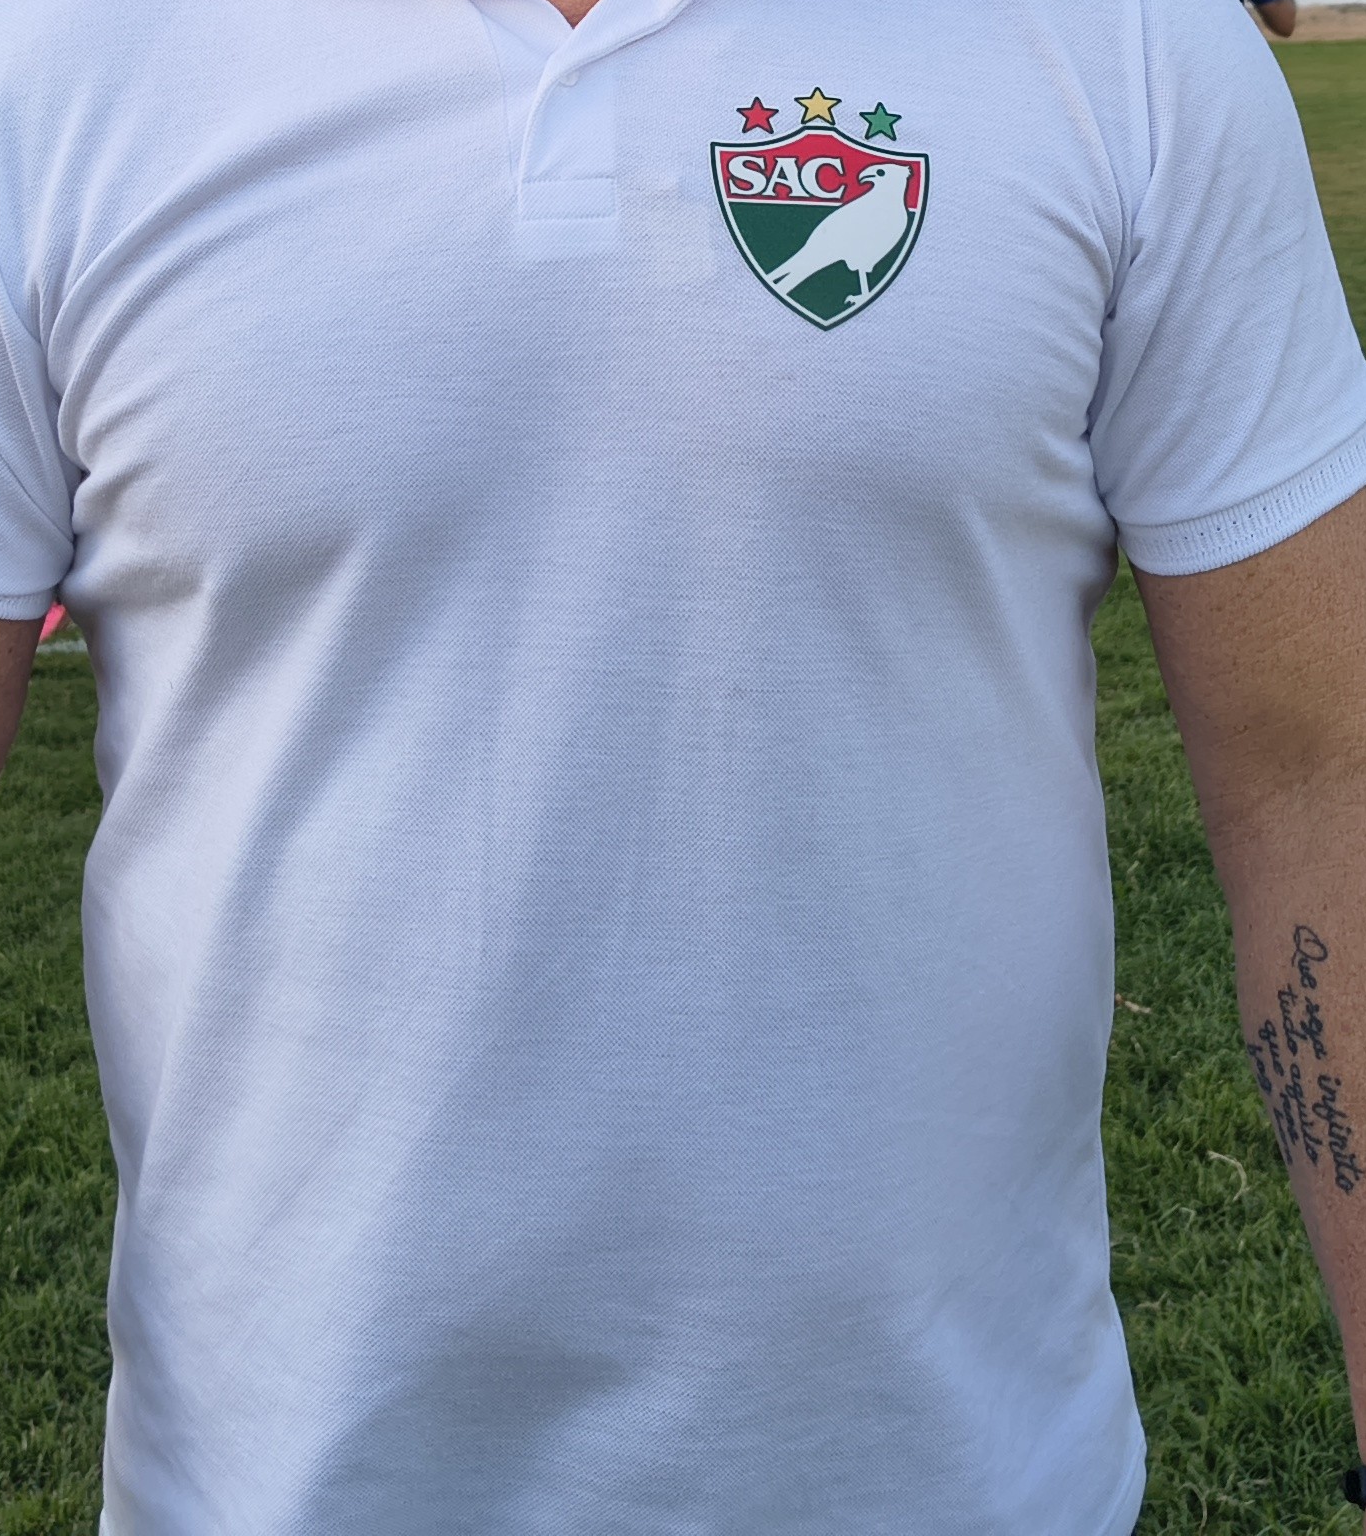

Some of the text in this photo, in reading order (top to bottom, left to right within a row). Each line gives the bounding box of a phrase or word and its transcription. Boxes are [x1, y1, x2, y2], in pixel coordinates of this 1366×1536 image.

[727, 154, 846, 200] SAC
[1277, 983, 1323, 1168] tudo aquilo
[1292, 924, 1328, 990] Que
[1313, 1073, 1365, 1196] infinito
